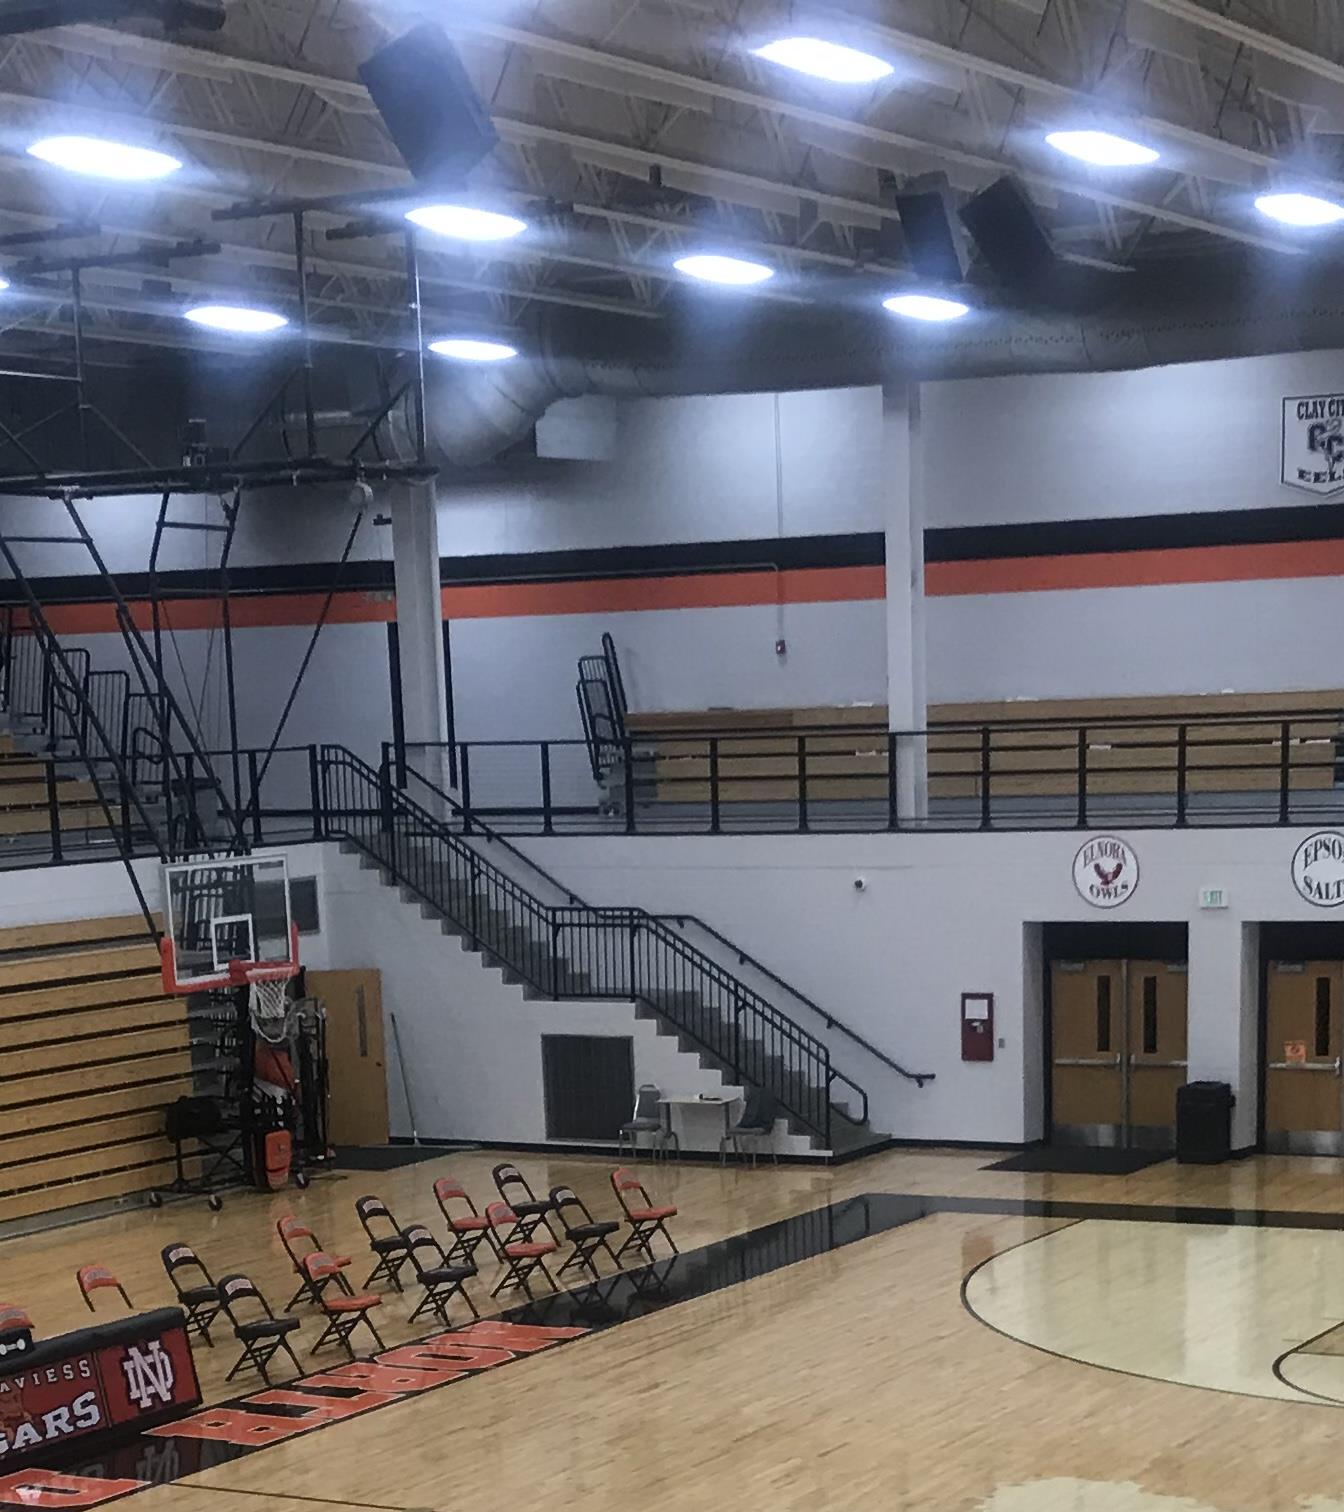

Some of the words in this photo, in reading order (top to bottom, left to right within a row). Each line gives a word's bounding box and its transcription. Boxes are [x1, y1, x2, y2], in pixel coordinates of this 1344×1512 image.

[1296, 400, 1325, 421] CLAY
[1082, 840, 1128, 868] ELNORA
[1089, 884, 1129, 900] OWLS
